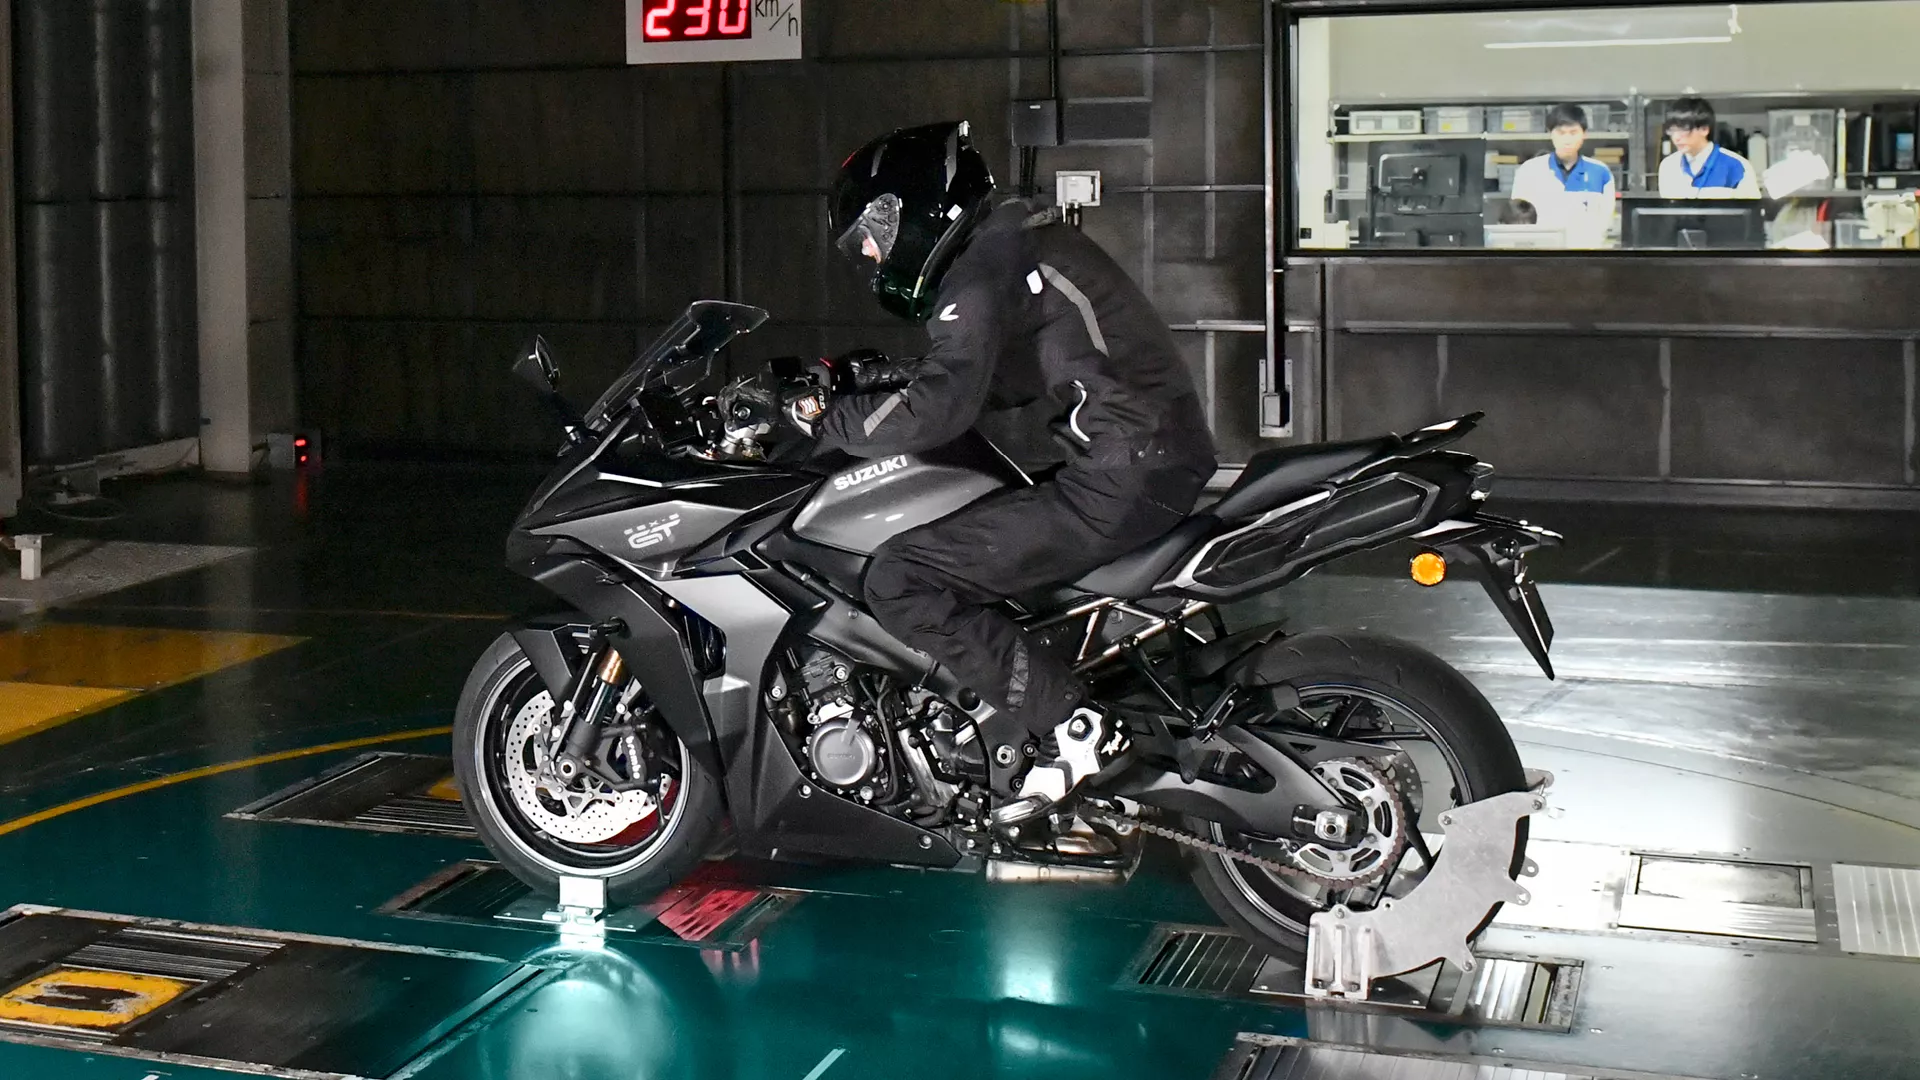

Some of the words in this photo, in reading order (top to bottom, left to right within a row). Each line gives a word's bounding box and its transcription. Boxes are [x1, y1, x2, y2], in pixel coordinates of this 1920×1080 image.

[645, 0, 747, 37] 230
[755, 0, 799, 36] km/h
[834, 455, 908, 490] SUZUKI
[628, 519, 680, 548] GT
